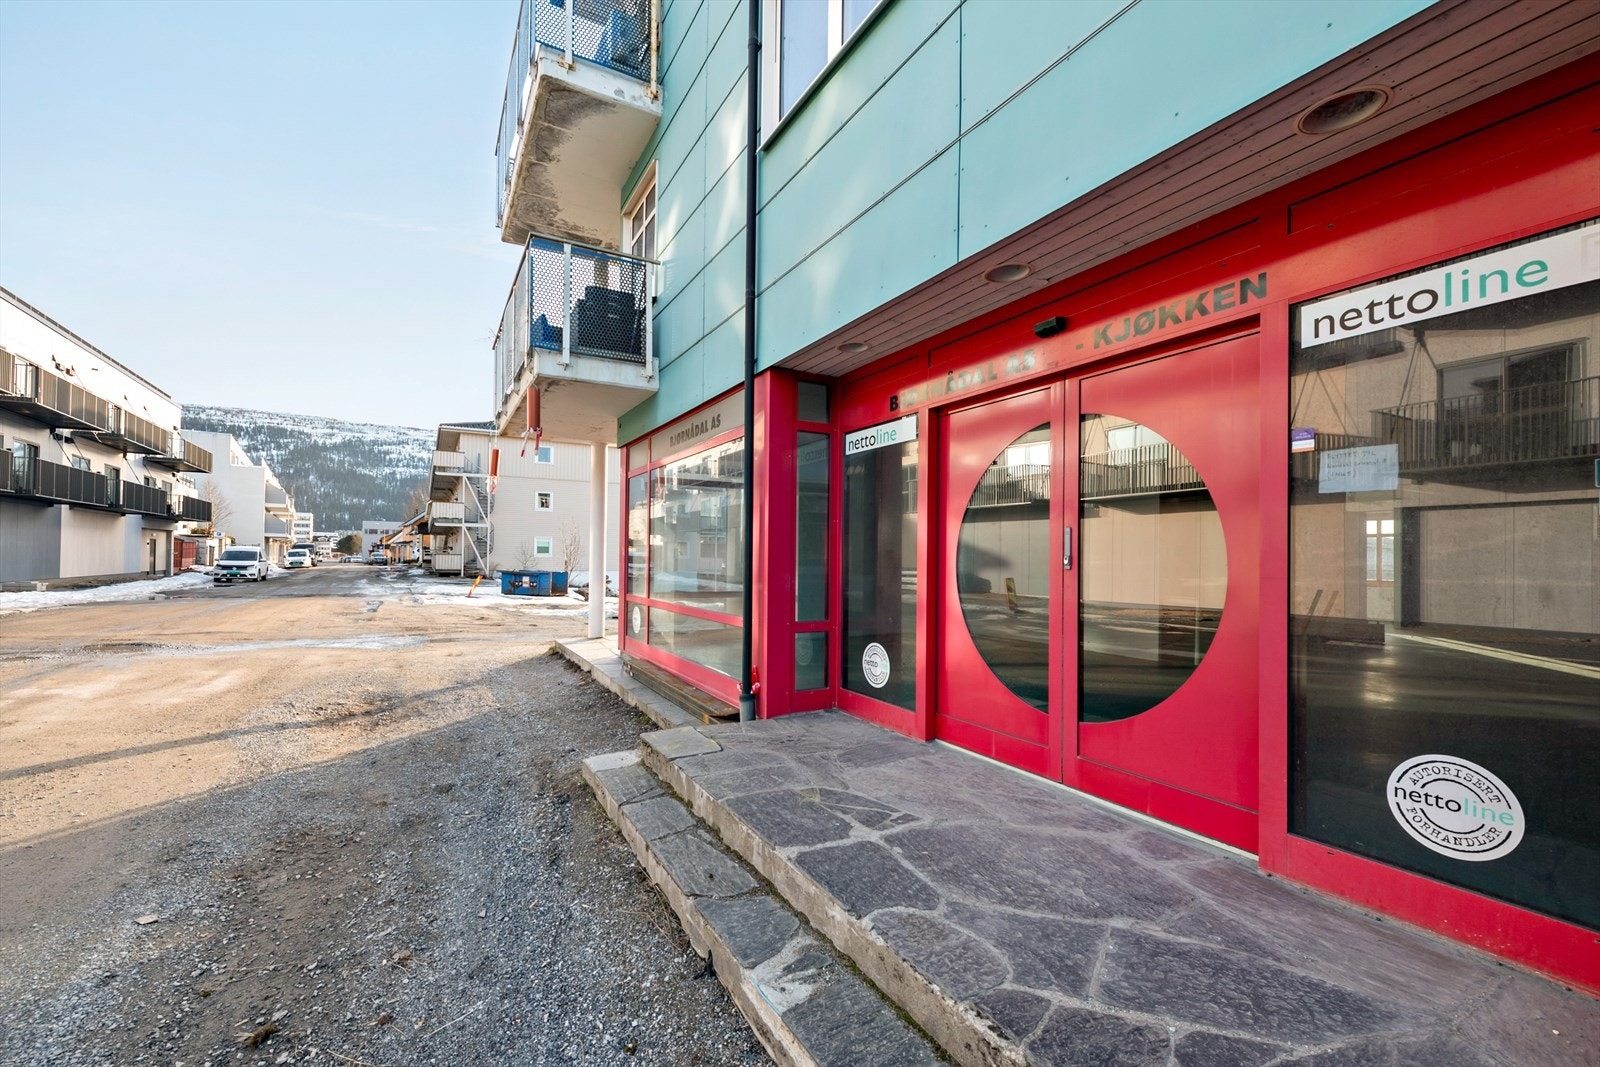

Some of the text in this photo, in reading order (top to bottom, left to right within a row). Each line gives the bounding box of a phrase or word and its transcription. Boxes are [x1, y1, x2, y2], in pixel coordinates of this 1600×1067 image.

[1313, 259, 1549, 339] nettoline
[1005, 348, 1034, 377] AS
[1093, 271, 1267, 350] KJØKKEN
[711, 413, 721, 430] AS
[848, 429, 897, 452] nettoline
[1409, 765, 1501, 804] AUTORISERT
[1394, 786, 1515, 827] nettoline
[1407, 806, 1502, 847] FORHANDLER
